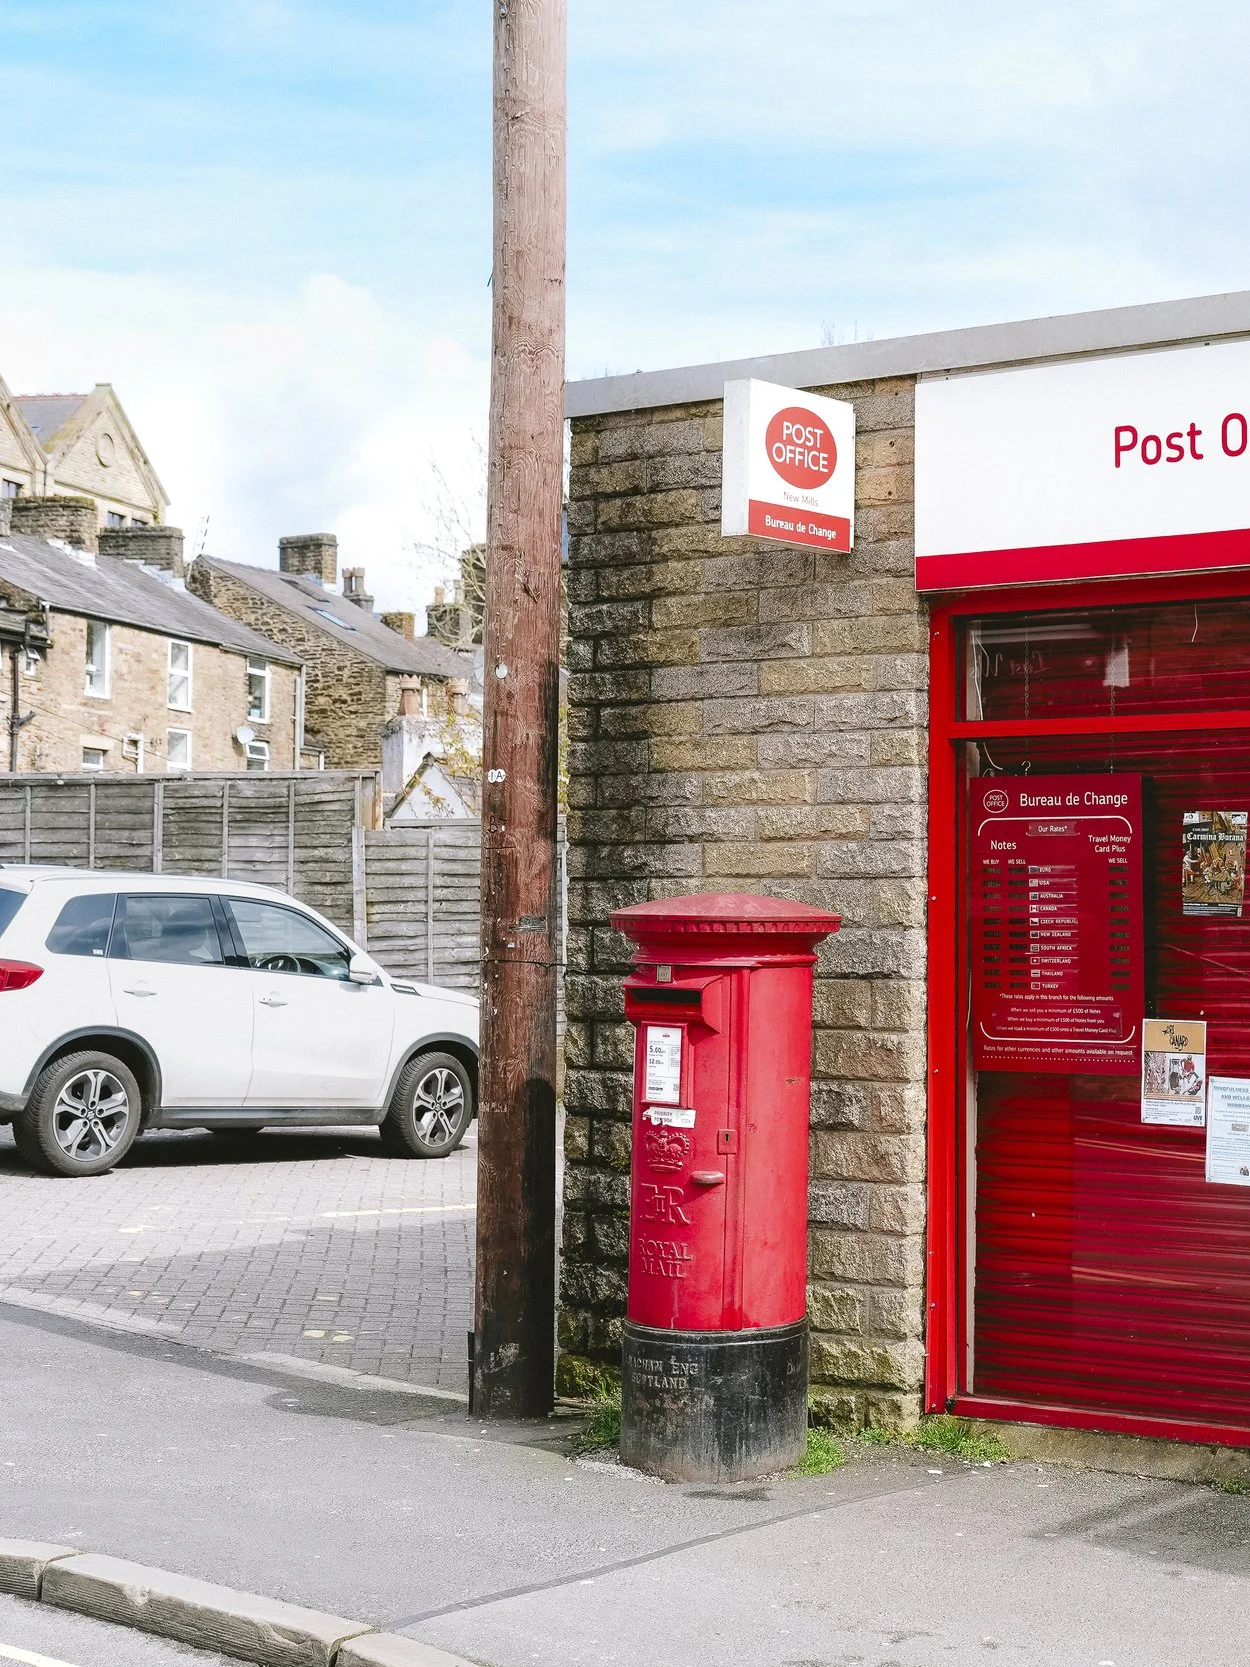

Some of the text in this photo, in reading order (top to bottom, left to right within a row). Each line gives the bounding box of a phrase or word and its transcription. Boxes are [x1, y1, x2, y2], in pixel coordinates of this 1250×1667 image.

[783, 421, 823, 448] POST
[1114, 423, 1203, 468] Post
[772, 443, 828, 473] OFFICE
[784, 492, 818, 506] New Mills
[765, 515, 837, 540] Bureau de Change
[1020, 792, 1128, 807] Bureau de Change
[991, 840, 1016, 850] Notes
[1110, 835, 1131, 843] Money
[1219, 833, 1243, 841] Burana
[639, 1238, 694, 1260] ROYAL
[641, 1257, 686, 1278] MAIL
[631, 1372, 689, 1389] SCOTLAND
